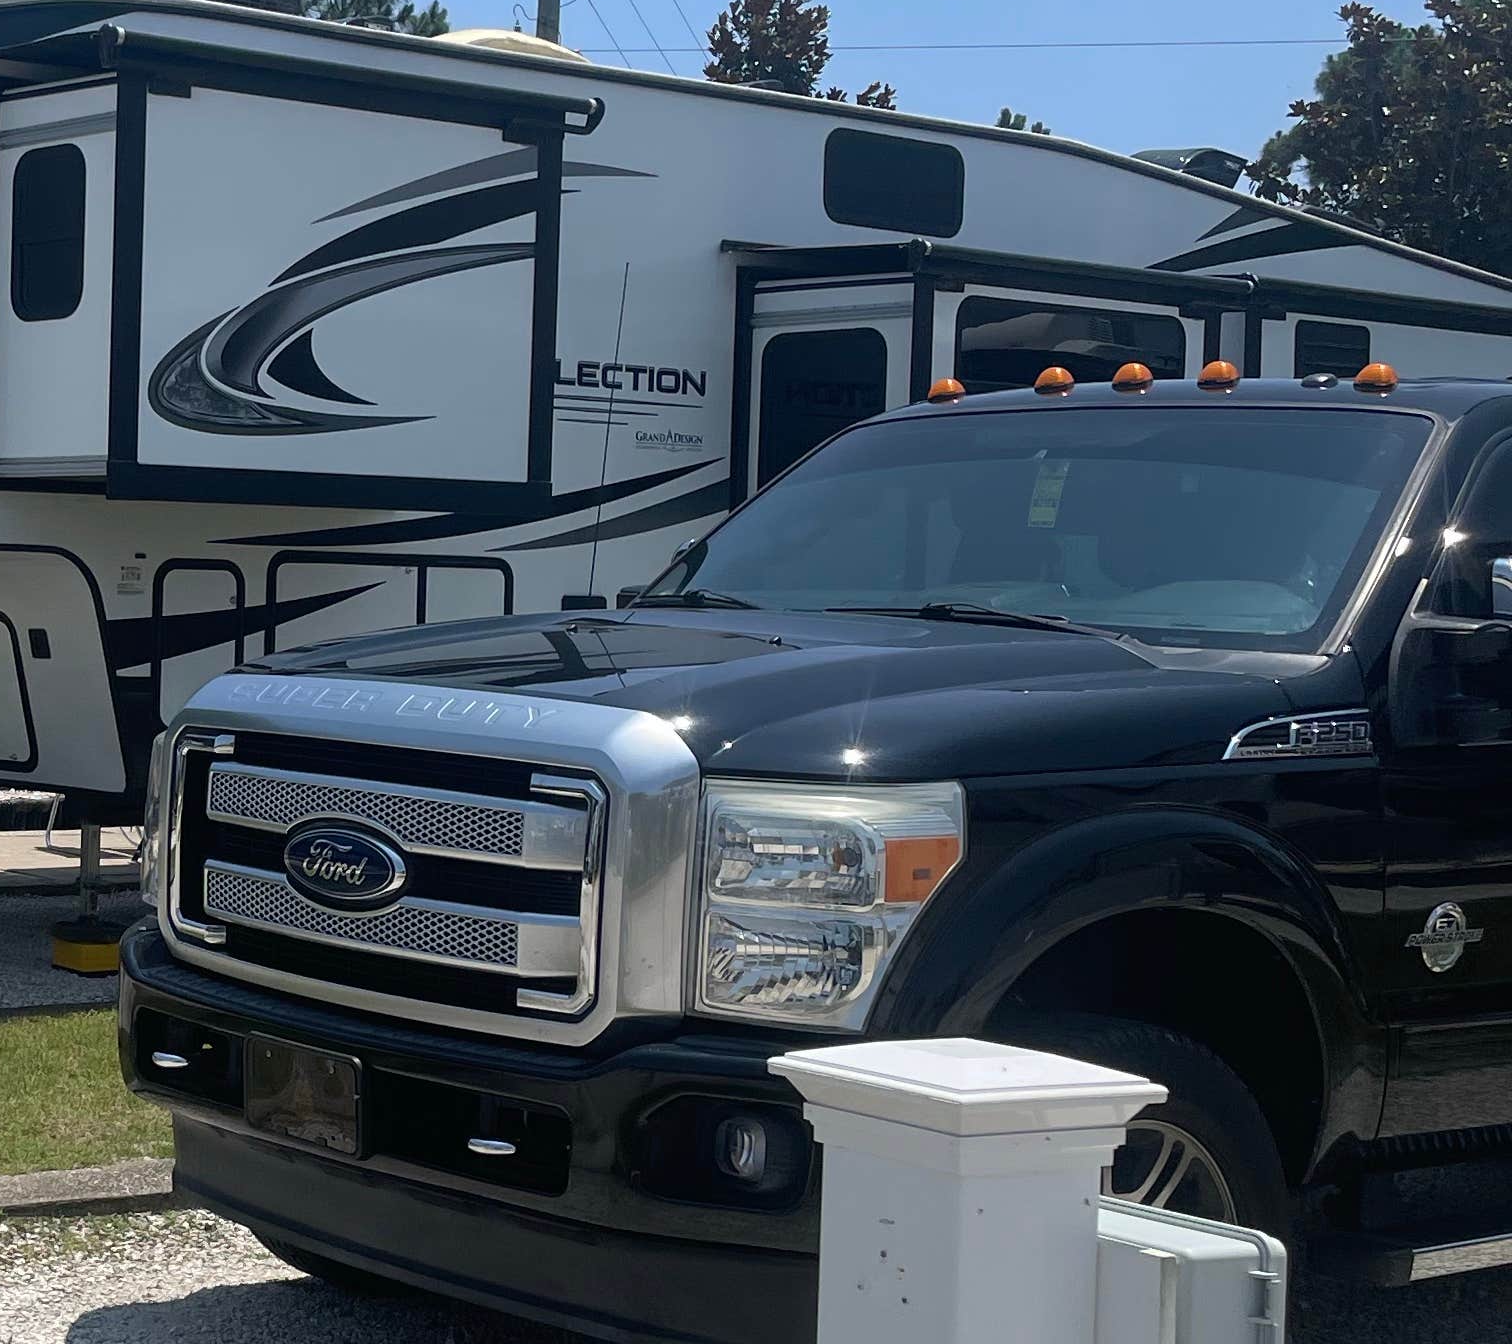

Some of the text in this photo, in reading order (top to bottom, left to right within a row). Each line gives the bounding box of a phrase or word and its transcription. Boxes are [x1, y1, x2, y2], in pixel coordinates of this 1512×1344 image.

[230, 683, 557, 729] SUPER DUTY
[302, 839, 368, 887] Ford
